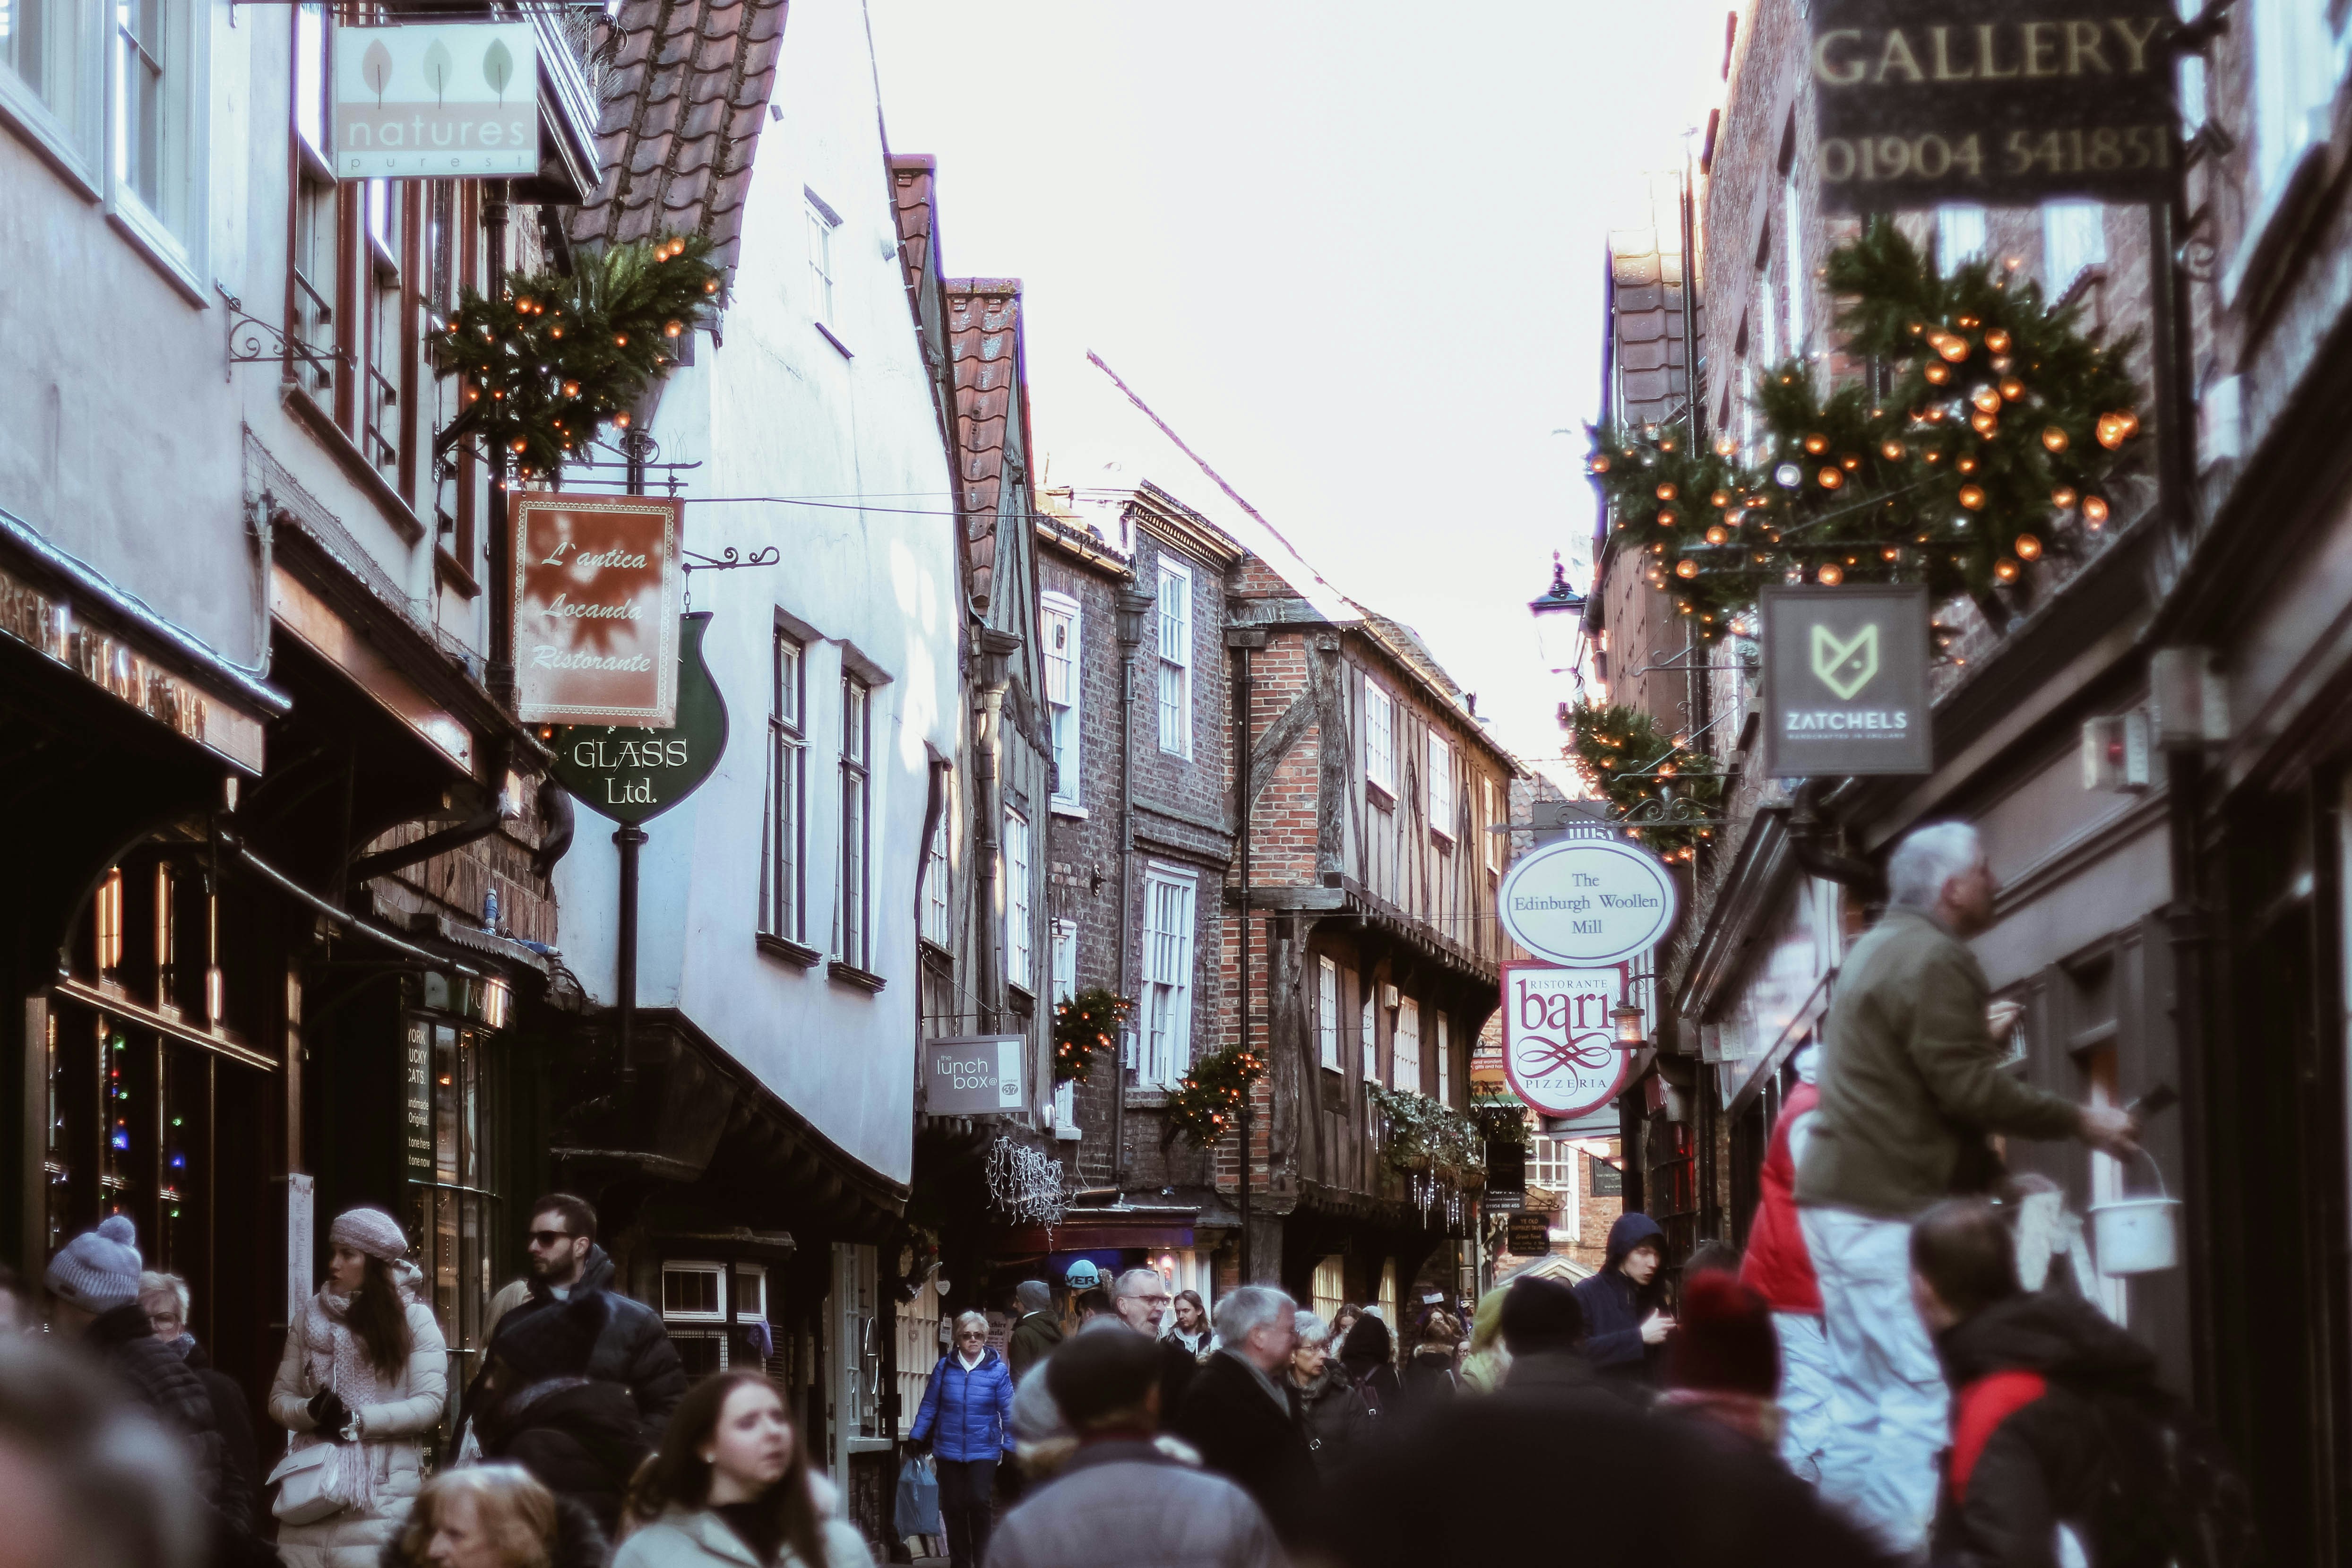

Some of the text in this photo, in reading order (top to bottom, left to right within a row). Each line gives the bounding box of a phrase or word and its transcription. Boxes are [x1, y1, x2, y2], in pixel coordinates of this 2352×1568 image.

[1814, 17, 2161, 86] GALLERY
[349, 115, 525, 146] natures
[1820, 124, 2171, 182] 01904 541851
[351, 155, 521, 170] purest
[542, 593, 643, 621] Locanda
[530, 645, 651, 672] Ristorante
[1786, 711, 1907, 730] ZATCHELS
[574, 738, 688, 773] GLASS
[605, 778, 657, 804] Ltd.
[1572, 873, 1600, 887] The
[1513, 894, 1659, 913] Edinburgh Woollen
[1572, 920, 1602, 935] Mill
[1530, 980, 1608, 990] RISTORANTE
[937, 1058, 988, 1075] lunch
[1003, 1086, 1017, 1094] 37
[1525, 1078, 1607, 1089] PIZZERIA
[408, 1112, 429, 1127] Original.
[411, 1139, 420, 1148] one
[420, 1137, 430, 1150] here
[411, 1156, 420, 1167] one
[421, 1158, 431, 1168] now
